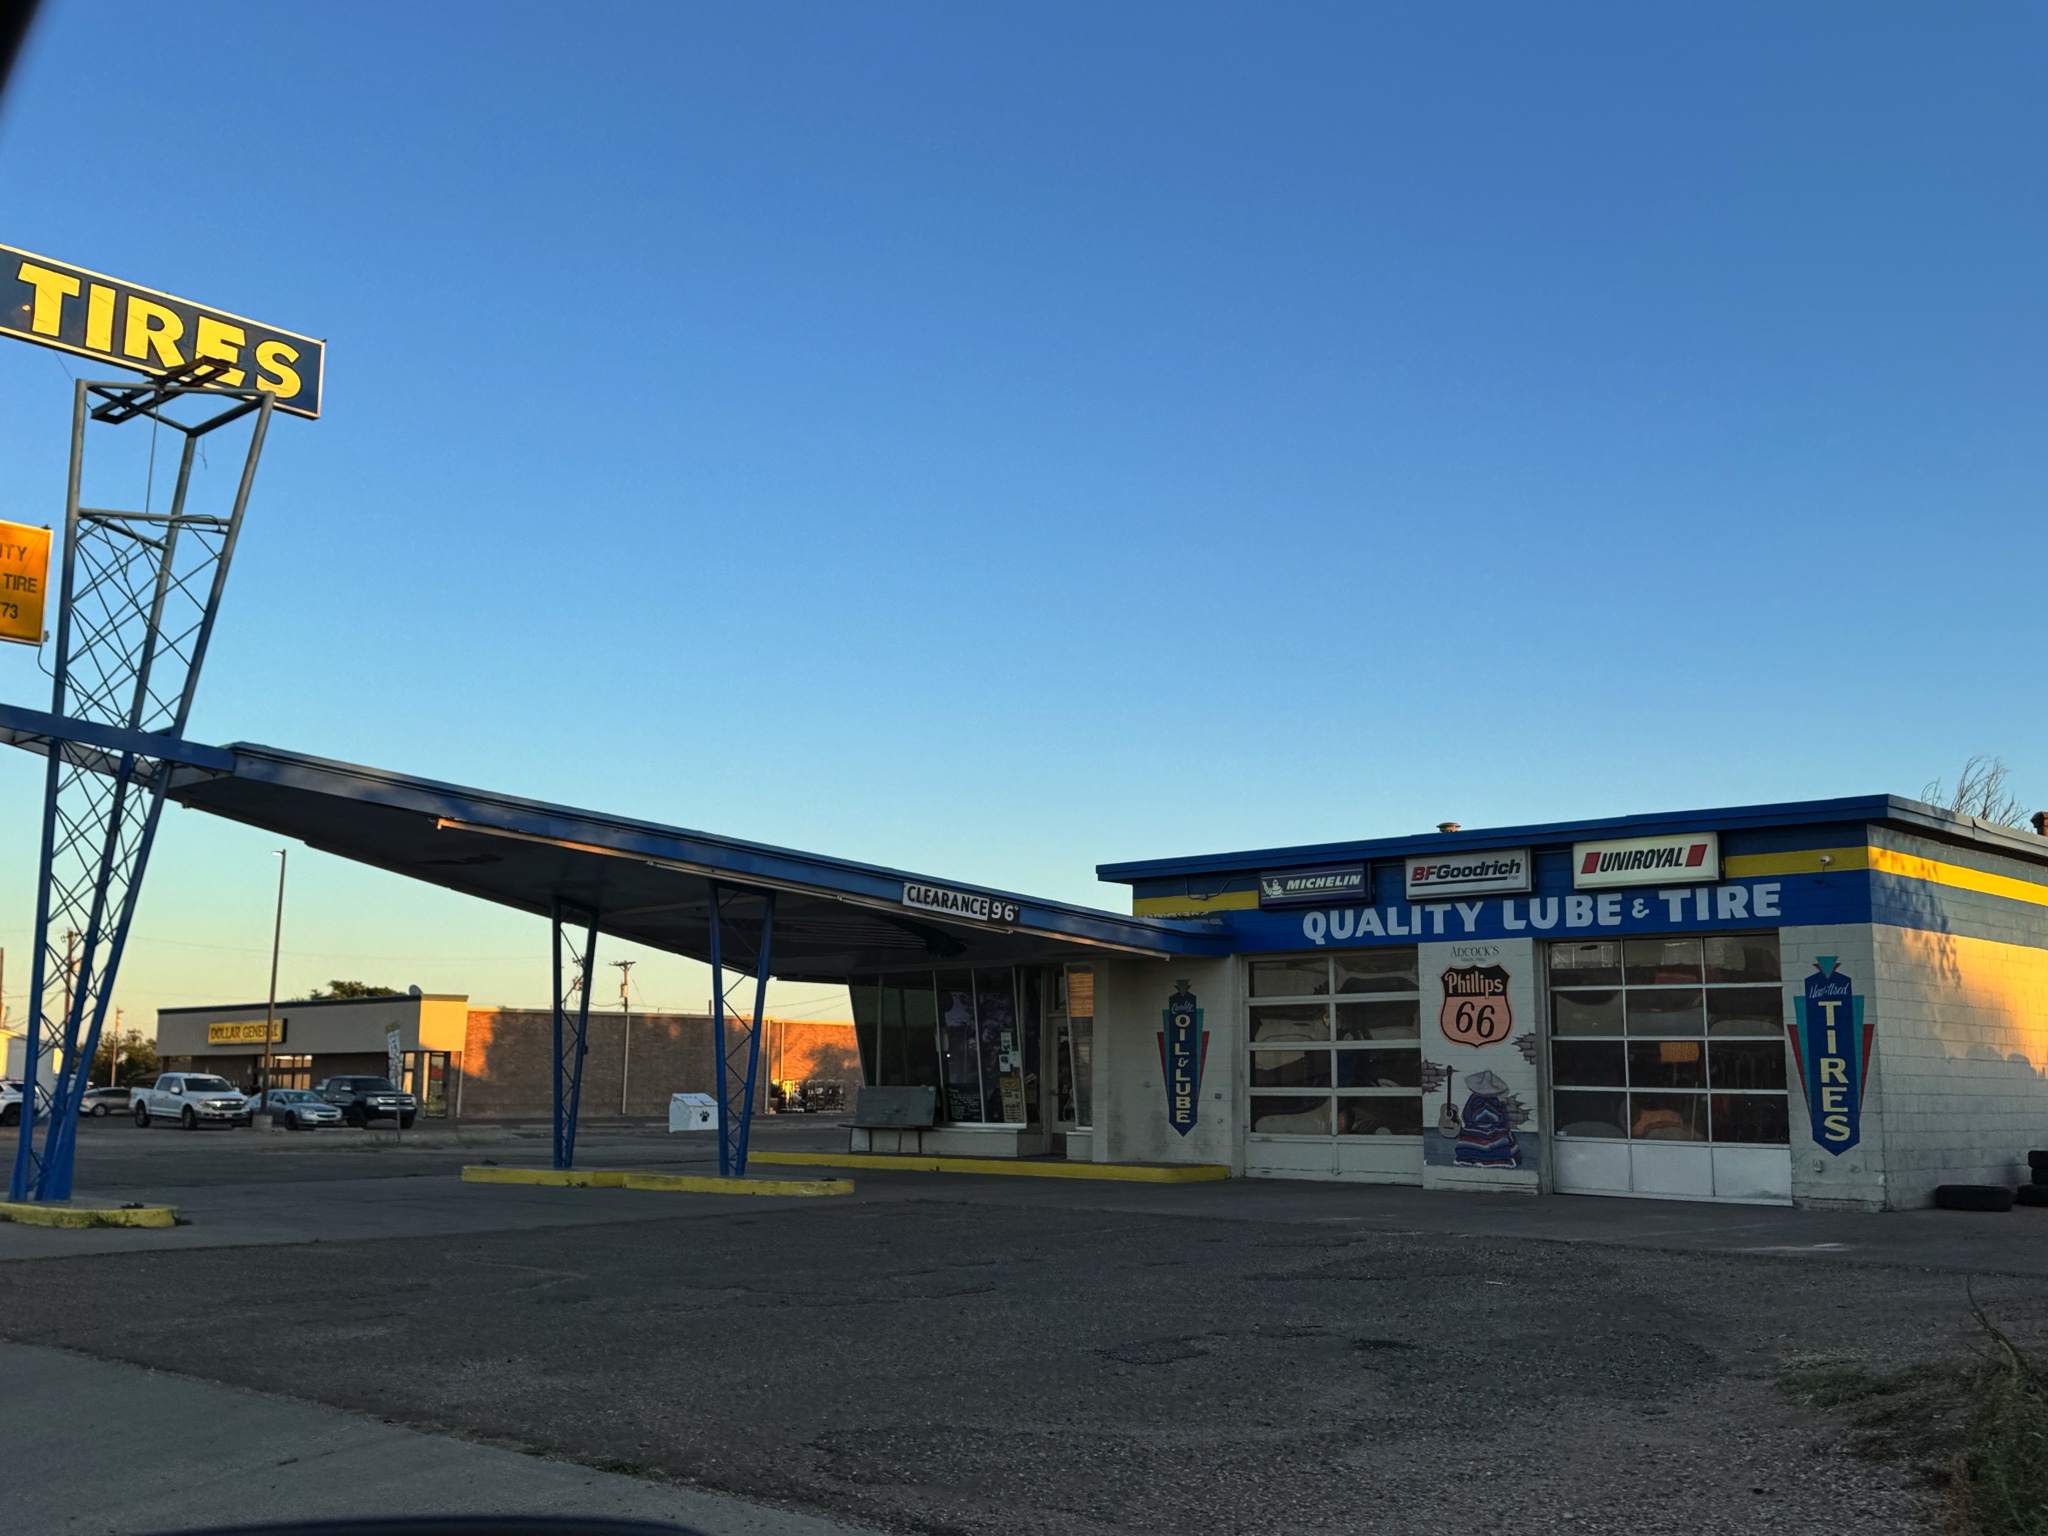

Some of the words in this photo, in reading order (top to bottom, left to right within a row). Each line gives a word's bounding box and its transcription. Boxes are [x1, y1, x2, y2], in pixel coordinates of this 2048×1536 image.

[17, 261, 302, 399] TIRES
[3, 573, 37, 593] TIRE
[1411, 859, 1521, 881] BFGoodrich
[1599, 847, 1683, 872] UNIROYAL
[1286, 874, 1361, 890] MICHELIN
[907, 886, 988, 916] CLEARANCE
[1303, 901, 1483, 944] QUALITY
[1502, 893, 1622, 930] LUBE
[1631, 898, 1650, 920] &
[1658, 882, 1781, 922] TIRE
[1451, 945, 1499, 957] ADCOCK'S
[1445, 971, 1503, 999] Phillips
[210, 1026, 241, 1040] DOLLAR
[1455, 1001, 1495, 1039] 66
[1174, 1014, 1191, 1055] OIL
[1178, 1057, 1189, 1067] &
[1818, 1001, 1850, 1142] TIRES
[1175, 1068, 1191, 1123] LUBE
